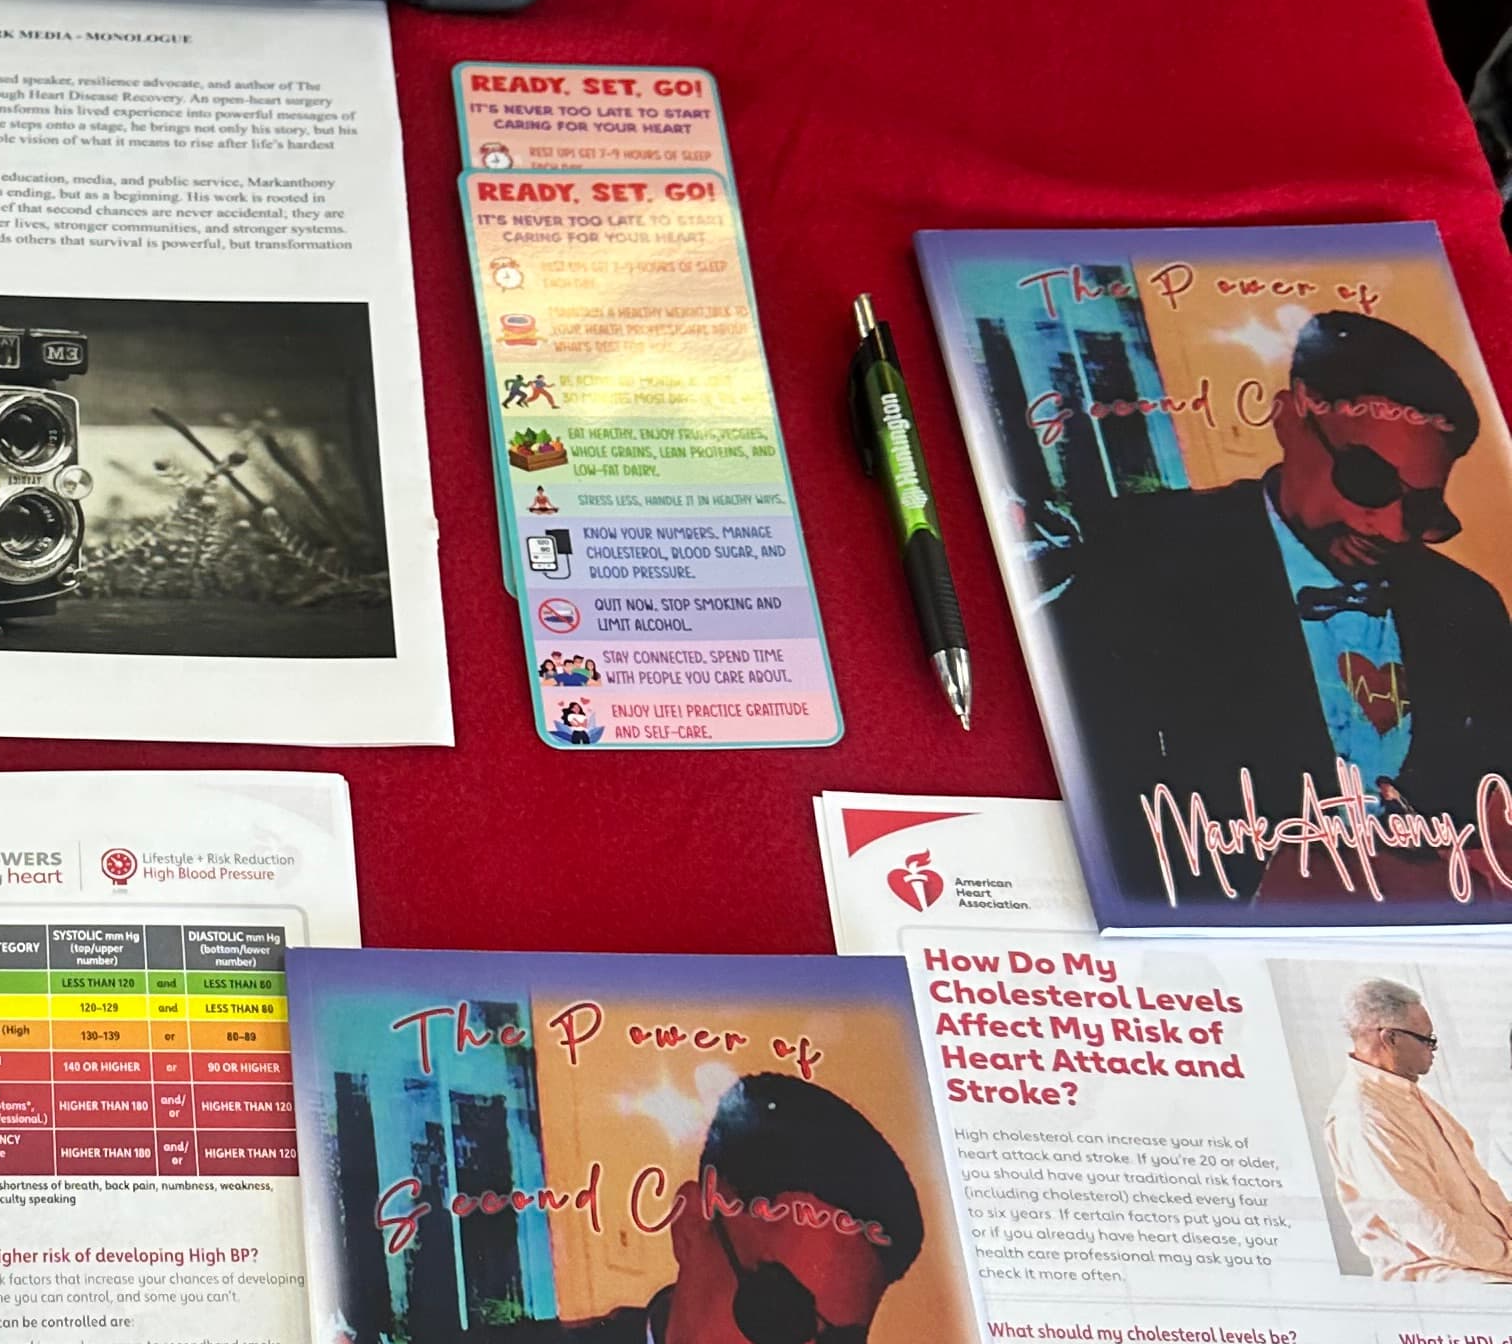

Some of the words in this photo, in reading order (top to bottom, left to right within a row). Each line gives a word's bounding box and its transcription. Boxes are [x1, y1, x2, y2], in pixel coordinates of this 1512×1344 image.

[18, 30, 72, 42] MEDIA
[86, 31, 193, 45] MONOLOGUE
[654, 78, 703, 98] GO!
[470, 103, 499, 117] IT'S
[504, 104, 552, 116] NEVER
[559, 106, 591, 118] TOO
[596, 107, 634, 118] LATE
[638, 107, 658, 119] TO
[665, 108, 711, 119] START
[1018, 264, 1134, 322] The
[1336, 283, 1382, 312] of
[881, 392, 919, 488] Huntington
[612, 704, 650, 718] ENJOY
[655, 703, 684, 718] LIFE!
[687, 703, 742, 717] PRACTICE
[746, 702, 809, 717] GRATITUDE
[615, 725, 640, 739] AND
[645, 724, 713, 739] SELF-CARE.
[142, 852, 193, 866] Lifestyle
[207, 853, 229, 864] Risk
[232, 853, 295, 866] Reduction
[7, 868, 63, 885] heart
[143, 868, 175, 881] High
[178, 867, 216, 880] Blood
[219, 868, 275, 881] Pressure
[954, 877, 1013, 889] American
[955, 887, 993, 899] Heart
[923, 949, 1003, 972] How
[1008, 952, 1055, 975] Do
[1062, 954, 1117, 983] My
[929, 982, 1130, 1009] Cholesterol
[1138, 987, 1244, 1014] Levels
[392, 999, 528, 1075] The
[771, 1032, 821, 1077] of
[934, 1015, 1041, 1039] Affect
[1050, 1018, 1105, 1045] My
[1112, 1020, 1180, 1044] Risk
[1187, 1022, 1225, 1045] of
[942, 1045, 1046, 1072] Heart
[1051, 1049, 1167, 1075] Attack
[1173, 1054, 1245, 1080] and
[947, 1078, 1080, 1107] Stroke?
[41, 1246, 72, 1263] risk
[75, 1246, 91, 1263] of
[95, 1246, 184, 1267] developing
[189, 1246, 227, 1267] High
[230, 1246, 259, 1263] BP?
[988, 1322, 1035, 1339] What
[1039, 1324, 1093, 1340] should
[1097, 1326, 1123, 1344] my
[1127, 1324, 1217, 1343] cholesterol
[1220, 1327, 1262, 1344] levels
[1266, 1329, 1297, 1344] be?
